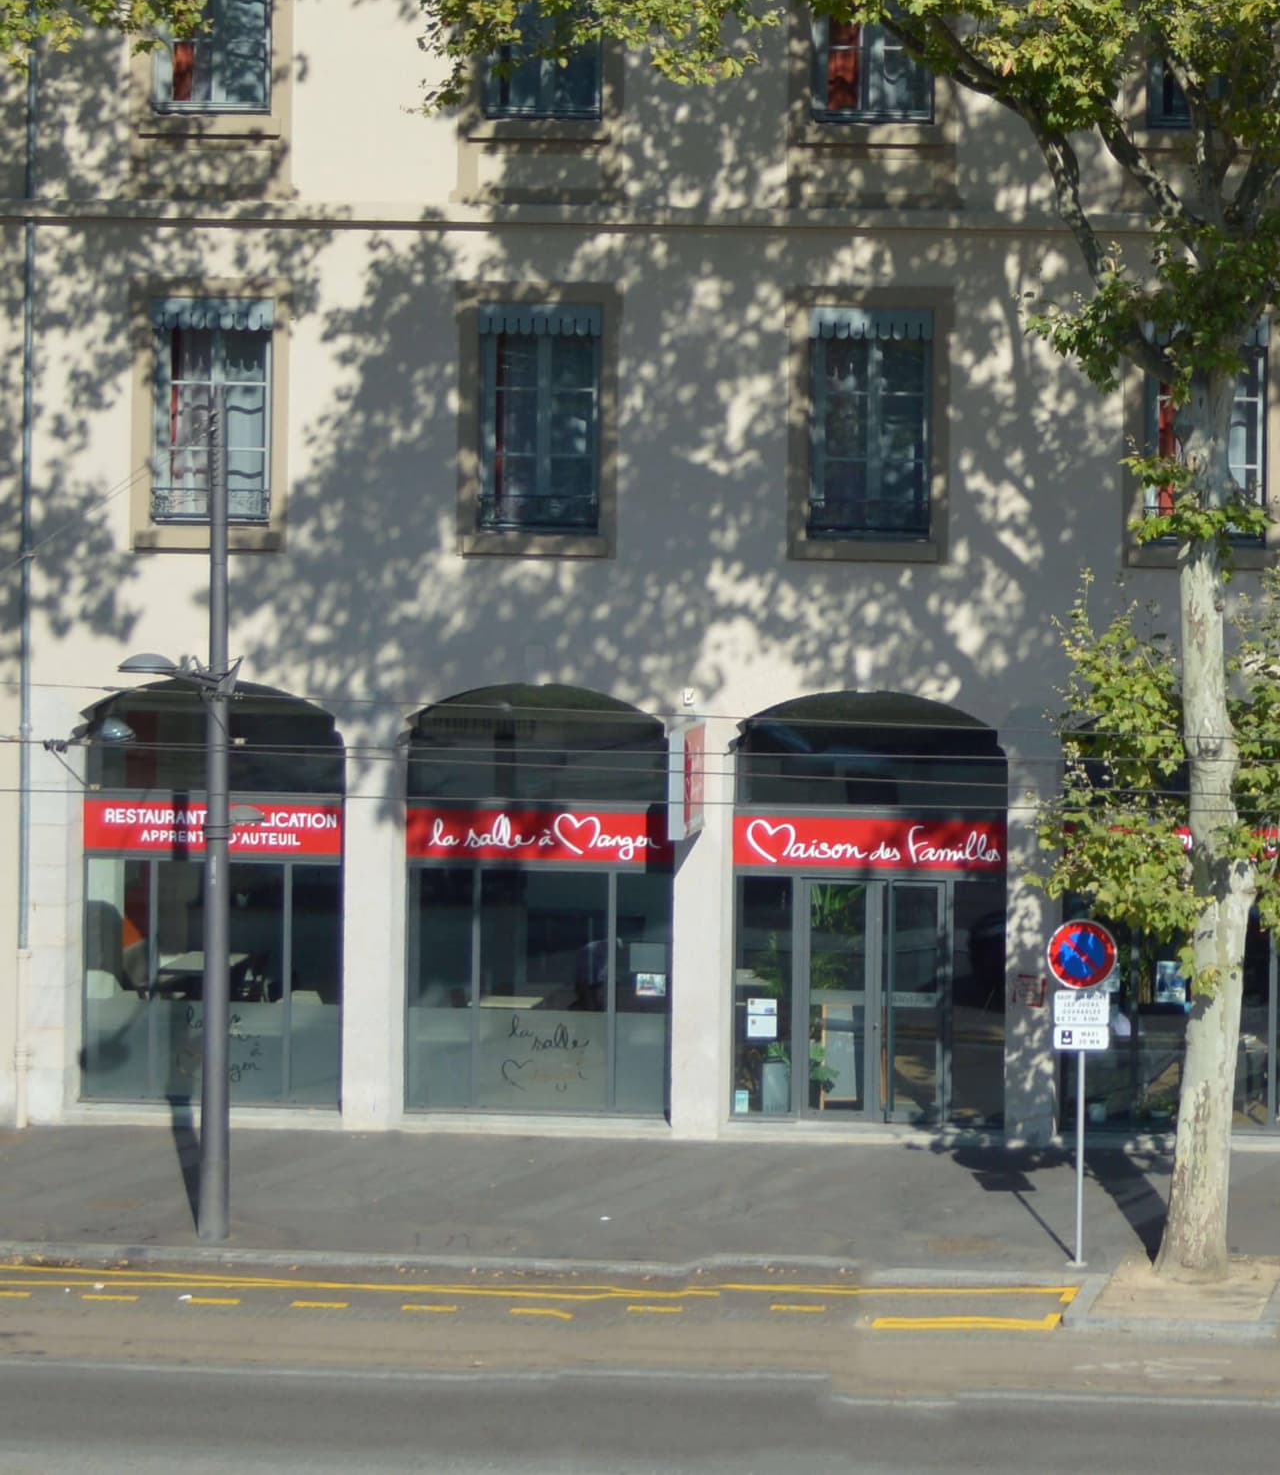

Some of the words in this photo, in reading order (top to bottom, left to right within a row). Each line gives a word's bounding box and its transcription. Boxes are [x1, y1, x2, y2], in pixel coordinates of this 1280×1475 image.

[104, 807, 208, 825] RESTAURANT
[236, 811, 338, 829] LICATION
[429, 818, 459, 847] la
[464, 813, 536, 849] salle
[140, 830, 205, 844] APPRENT
[868, 841, 901, 862] des
[907, 825, 1002, 864] Familles
